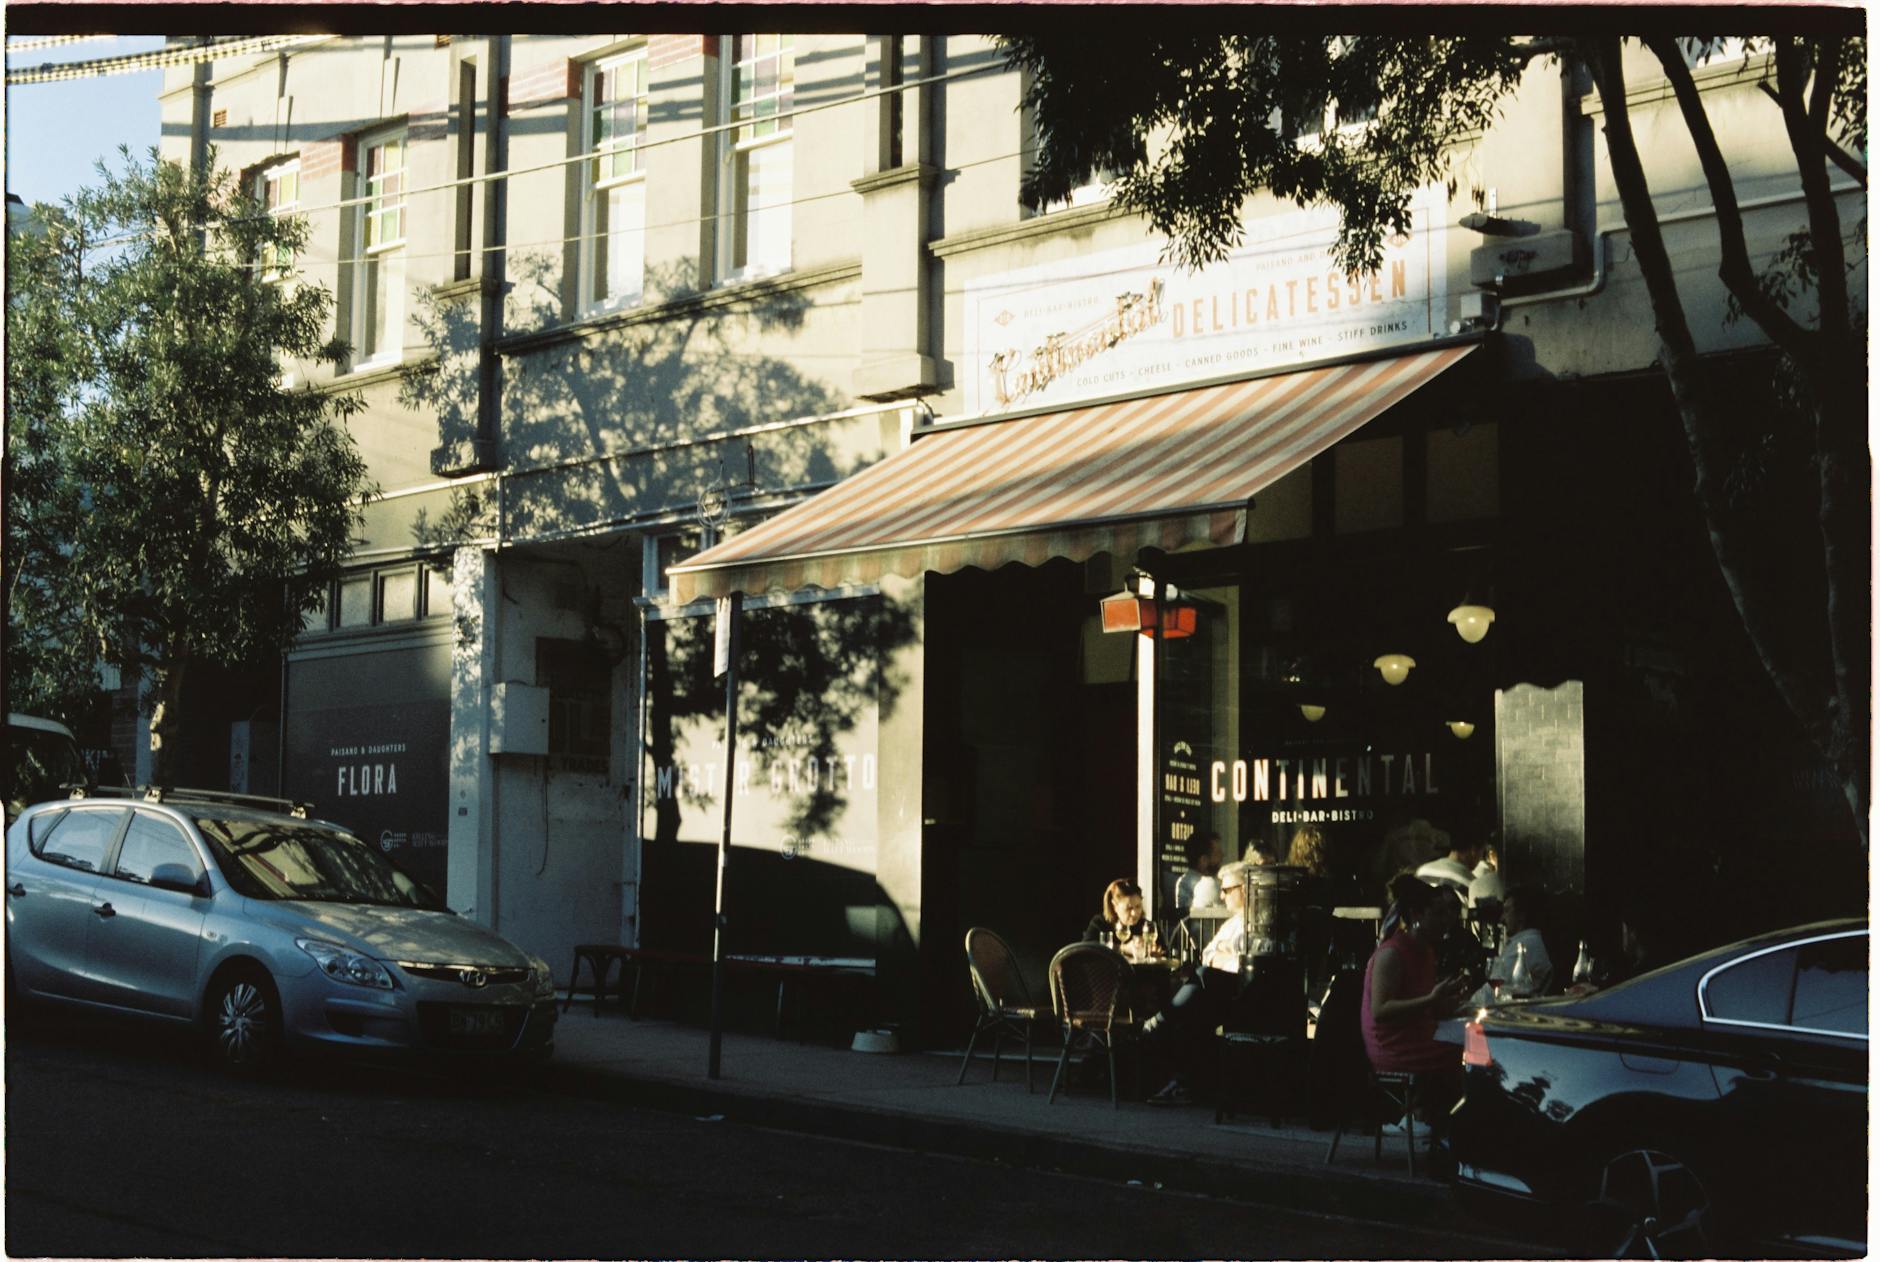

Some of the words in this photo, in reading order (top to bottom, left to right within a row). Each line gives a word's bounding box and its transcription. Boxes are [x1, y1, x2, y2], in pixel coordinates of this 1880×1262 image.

[1172, 259, 1407, 338] DELICATESSEN
[1076, 376, 1100, 388] COLD
[1103, 371, 1126, 383] CUTS
[1138, 362, 1171, 377] CHEESE
[1185, 354, 1222, 369] CANNED
[1226, 347, 1259, 362] GOODS
[1272, 342, 1294, 353] FINE
[1300, 335, 1323, 348] WINE
[1337, 329, 1365, 341] STIFF
[1370, 321, 1408, 336] DRINKS
[331, 746, 358, 757] PAISANO
[368, 743, 406, 754] DAUGHTERS
[338, 763, 397, 796] FLORA
[656, 761, 750, 799] MISTR
[770, 752, 875, 793] GROTTO
[1211, 753, 1439, 802] CONTINENTAL
